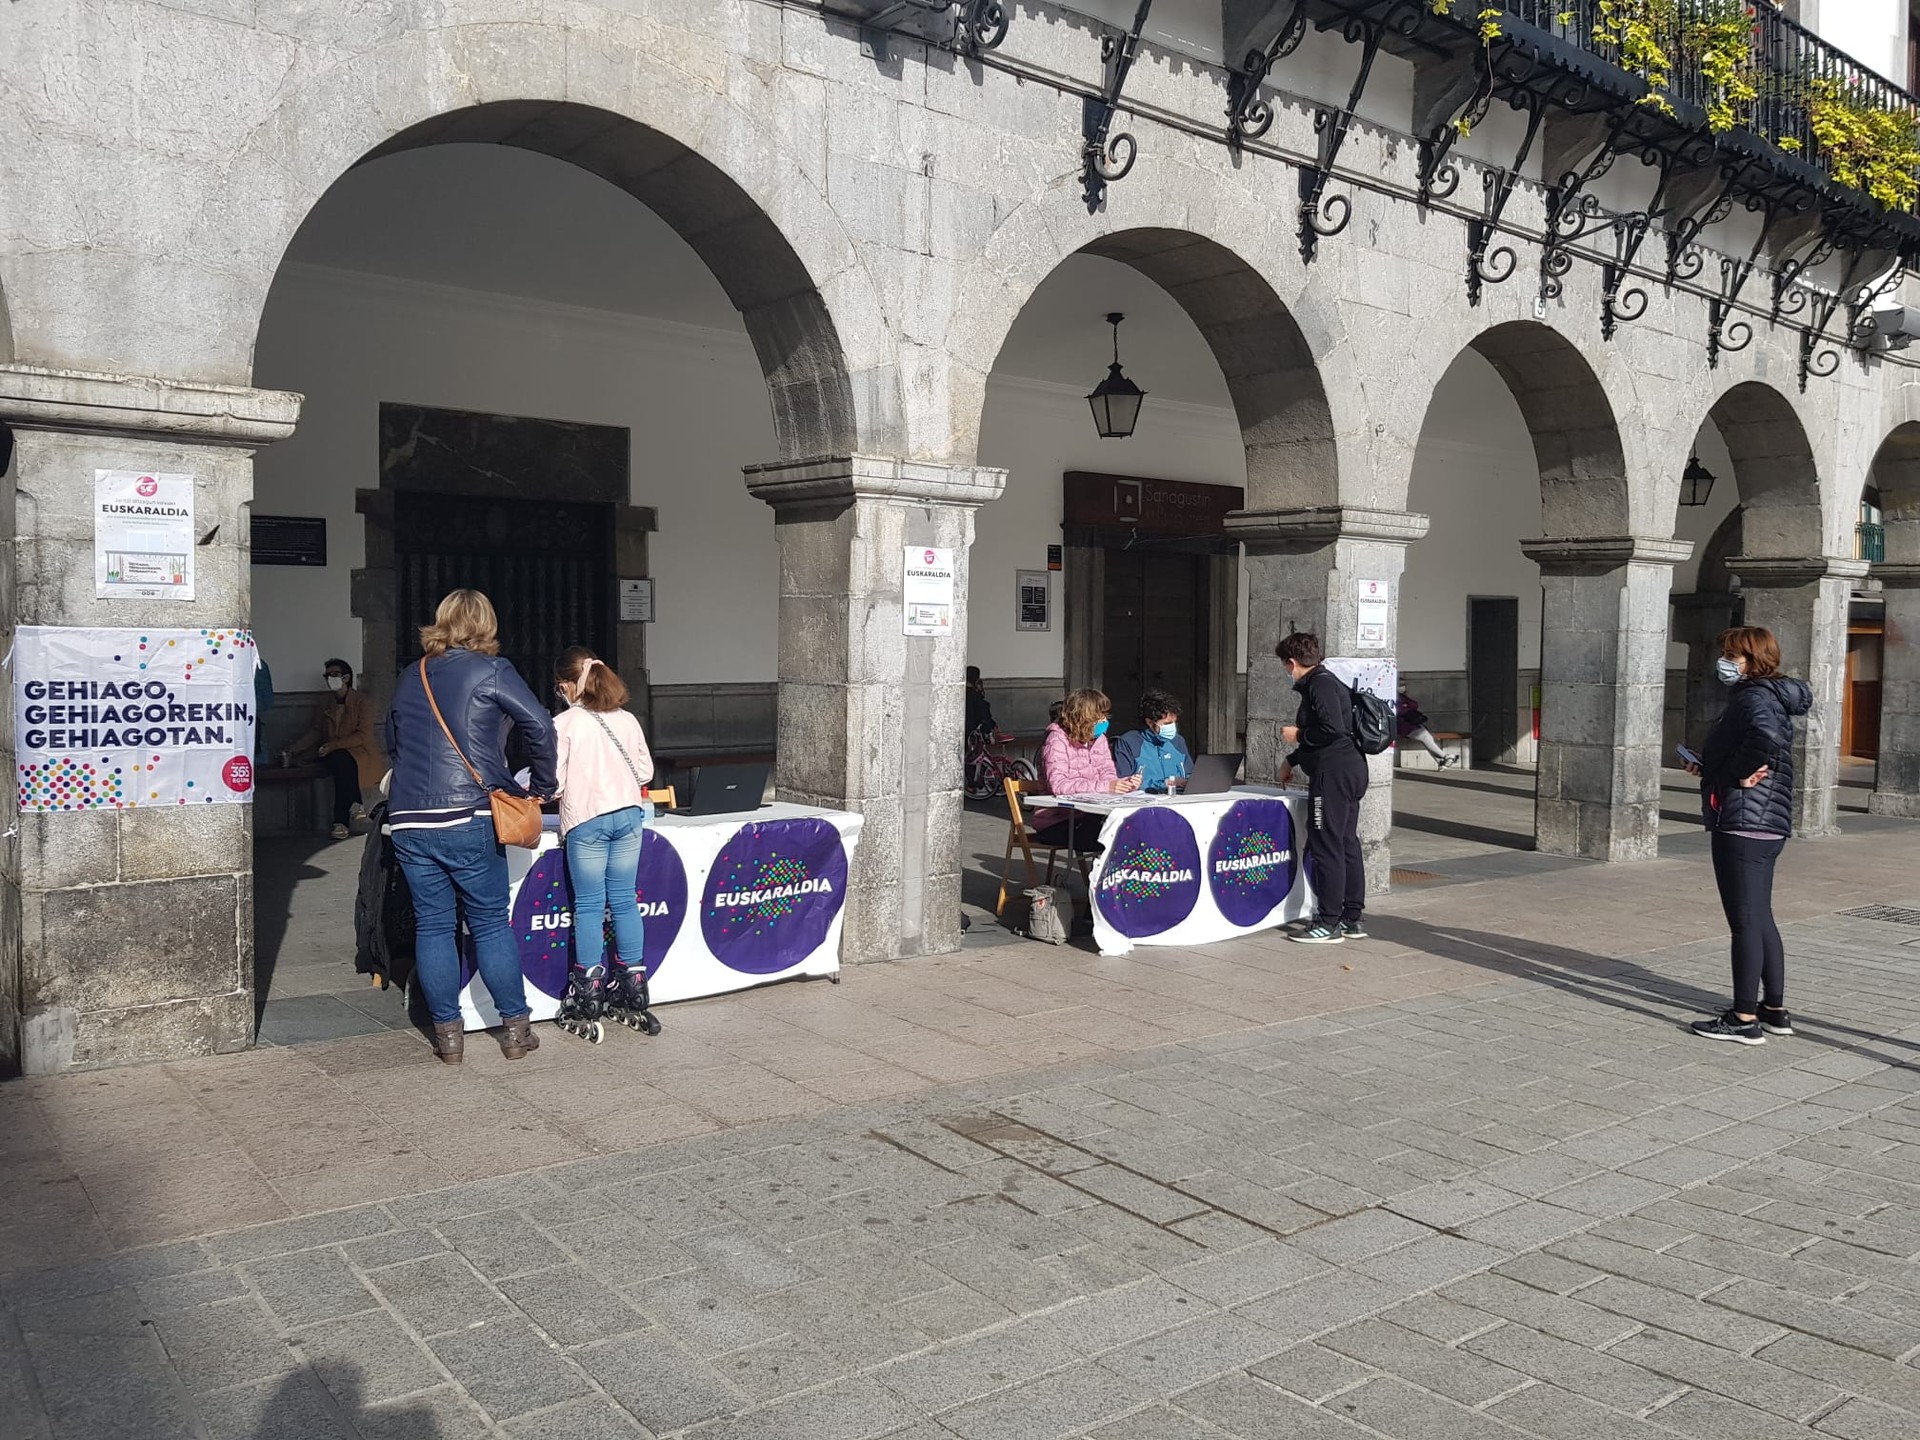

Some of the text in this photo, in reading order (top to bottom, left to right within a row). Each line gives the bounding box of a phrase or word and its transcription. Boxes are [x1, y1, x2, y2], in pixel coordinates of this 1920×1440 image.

[102, 504, 189, 517] EUSKARALDIA
[907, 570, 951, 578] EUSKARALDIA
[24, 680, 175, 704] GEHIAGO,
[25, 703, 254, 726] GEHIAGOREKIN,
[25, 726, 233, 748] GEHIAGOTAN.
[1215, 850, 1292, 873] EUSKARALDIA
[1102, 868, 1193, 891] EUSKARALDIA
[714, 877, 833, 908] EUSKARALDIA
[531, 901, 669, 931] EUSRDIA
